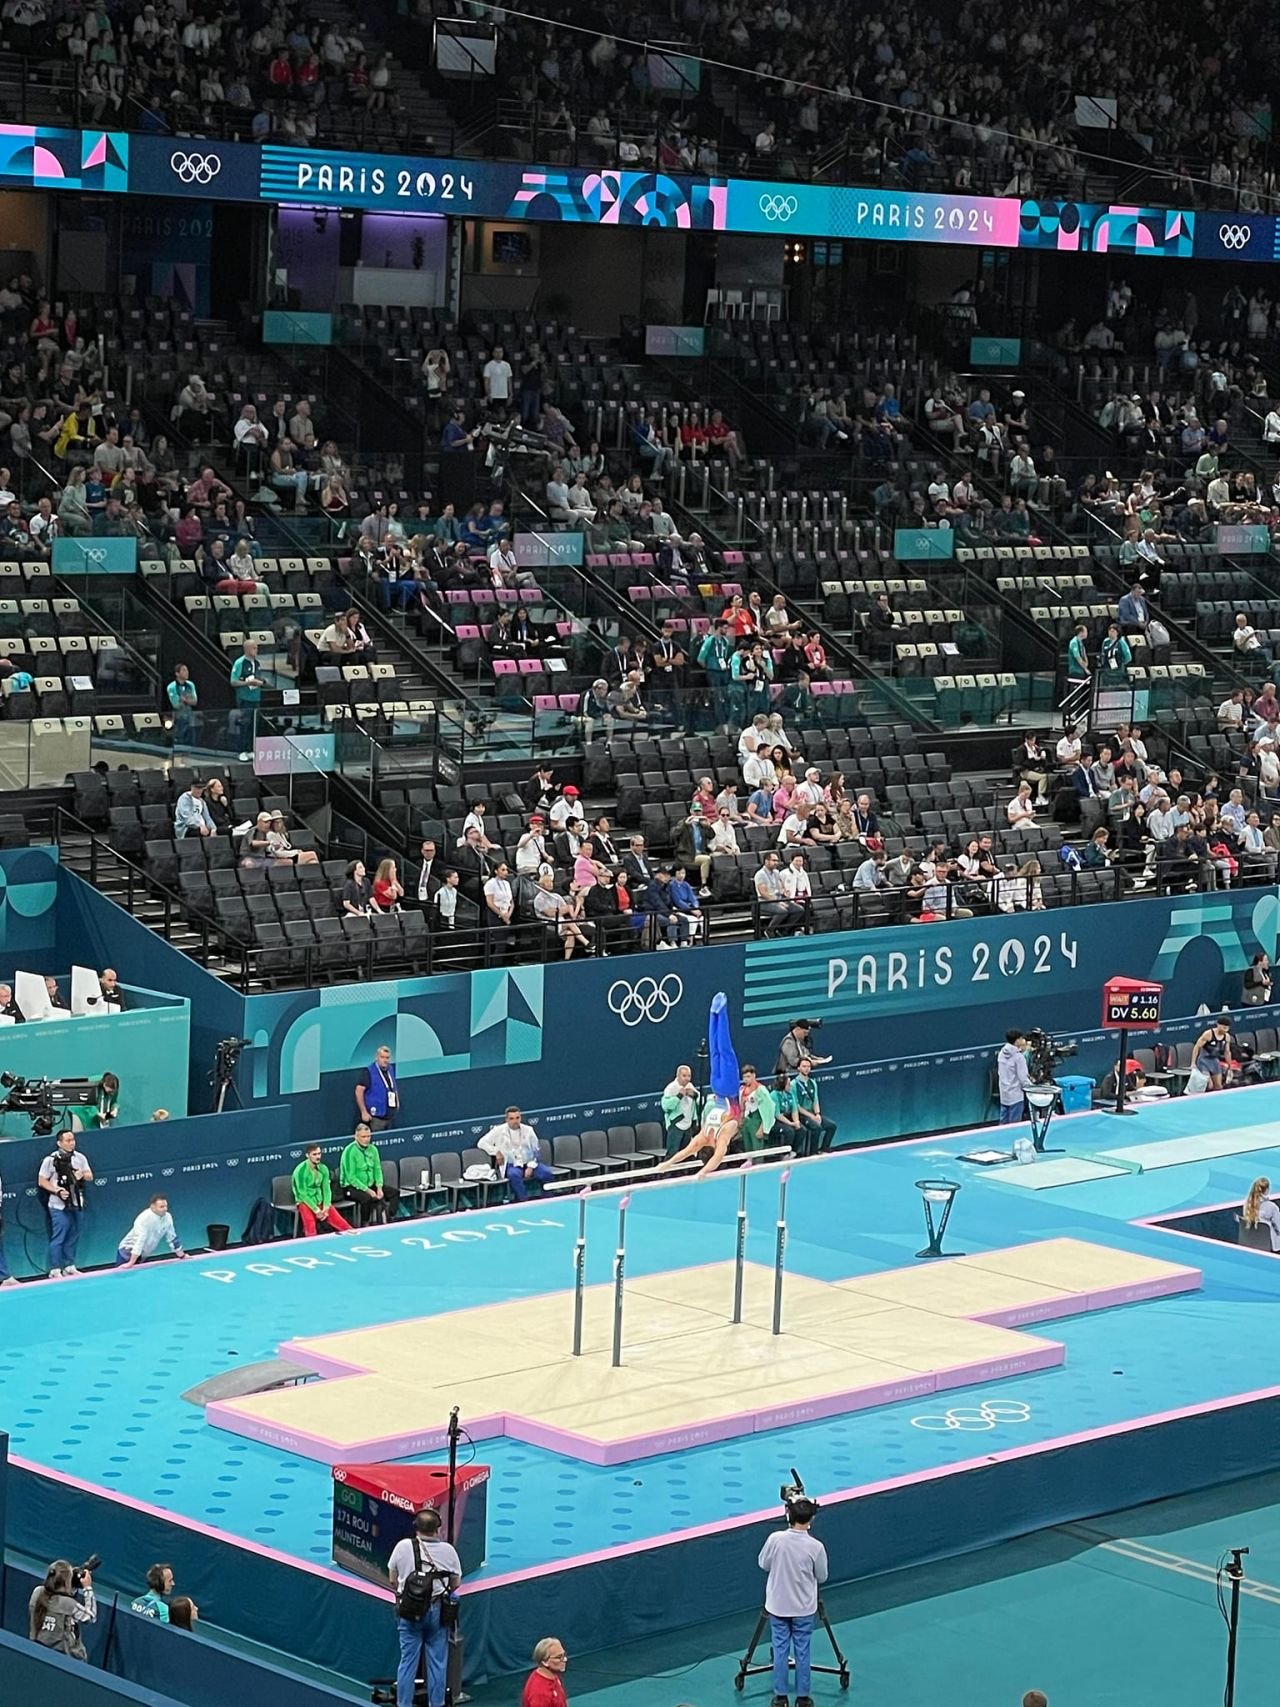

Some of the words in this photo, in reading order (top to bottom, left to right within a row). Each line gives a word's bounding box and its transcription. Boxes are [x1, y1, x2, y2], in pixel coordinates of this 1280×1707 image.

[397, 170, 473, 200] 2024
[934, 207, 993, 232] 2024
[971, 932, 1077, 982] 2024
[1111, 1007, 1129, 1019] DV
[1130, 1007, 1157, 1020] 5.60
[400, 1217, 566, 1250] 2024
[470, 1470, 489, 1488] OMEGA
[341, 1490, 356, 1505] GO
[388, 1493, 415, 1512] OMEGA
[352, 1515, 370, 1533] ROU
[334, 1527, 373, 1552] MUNTEAN
